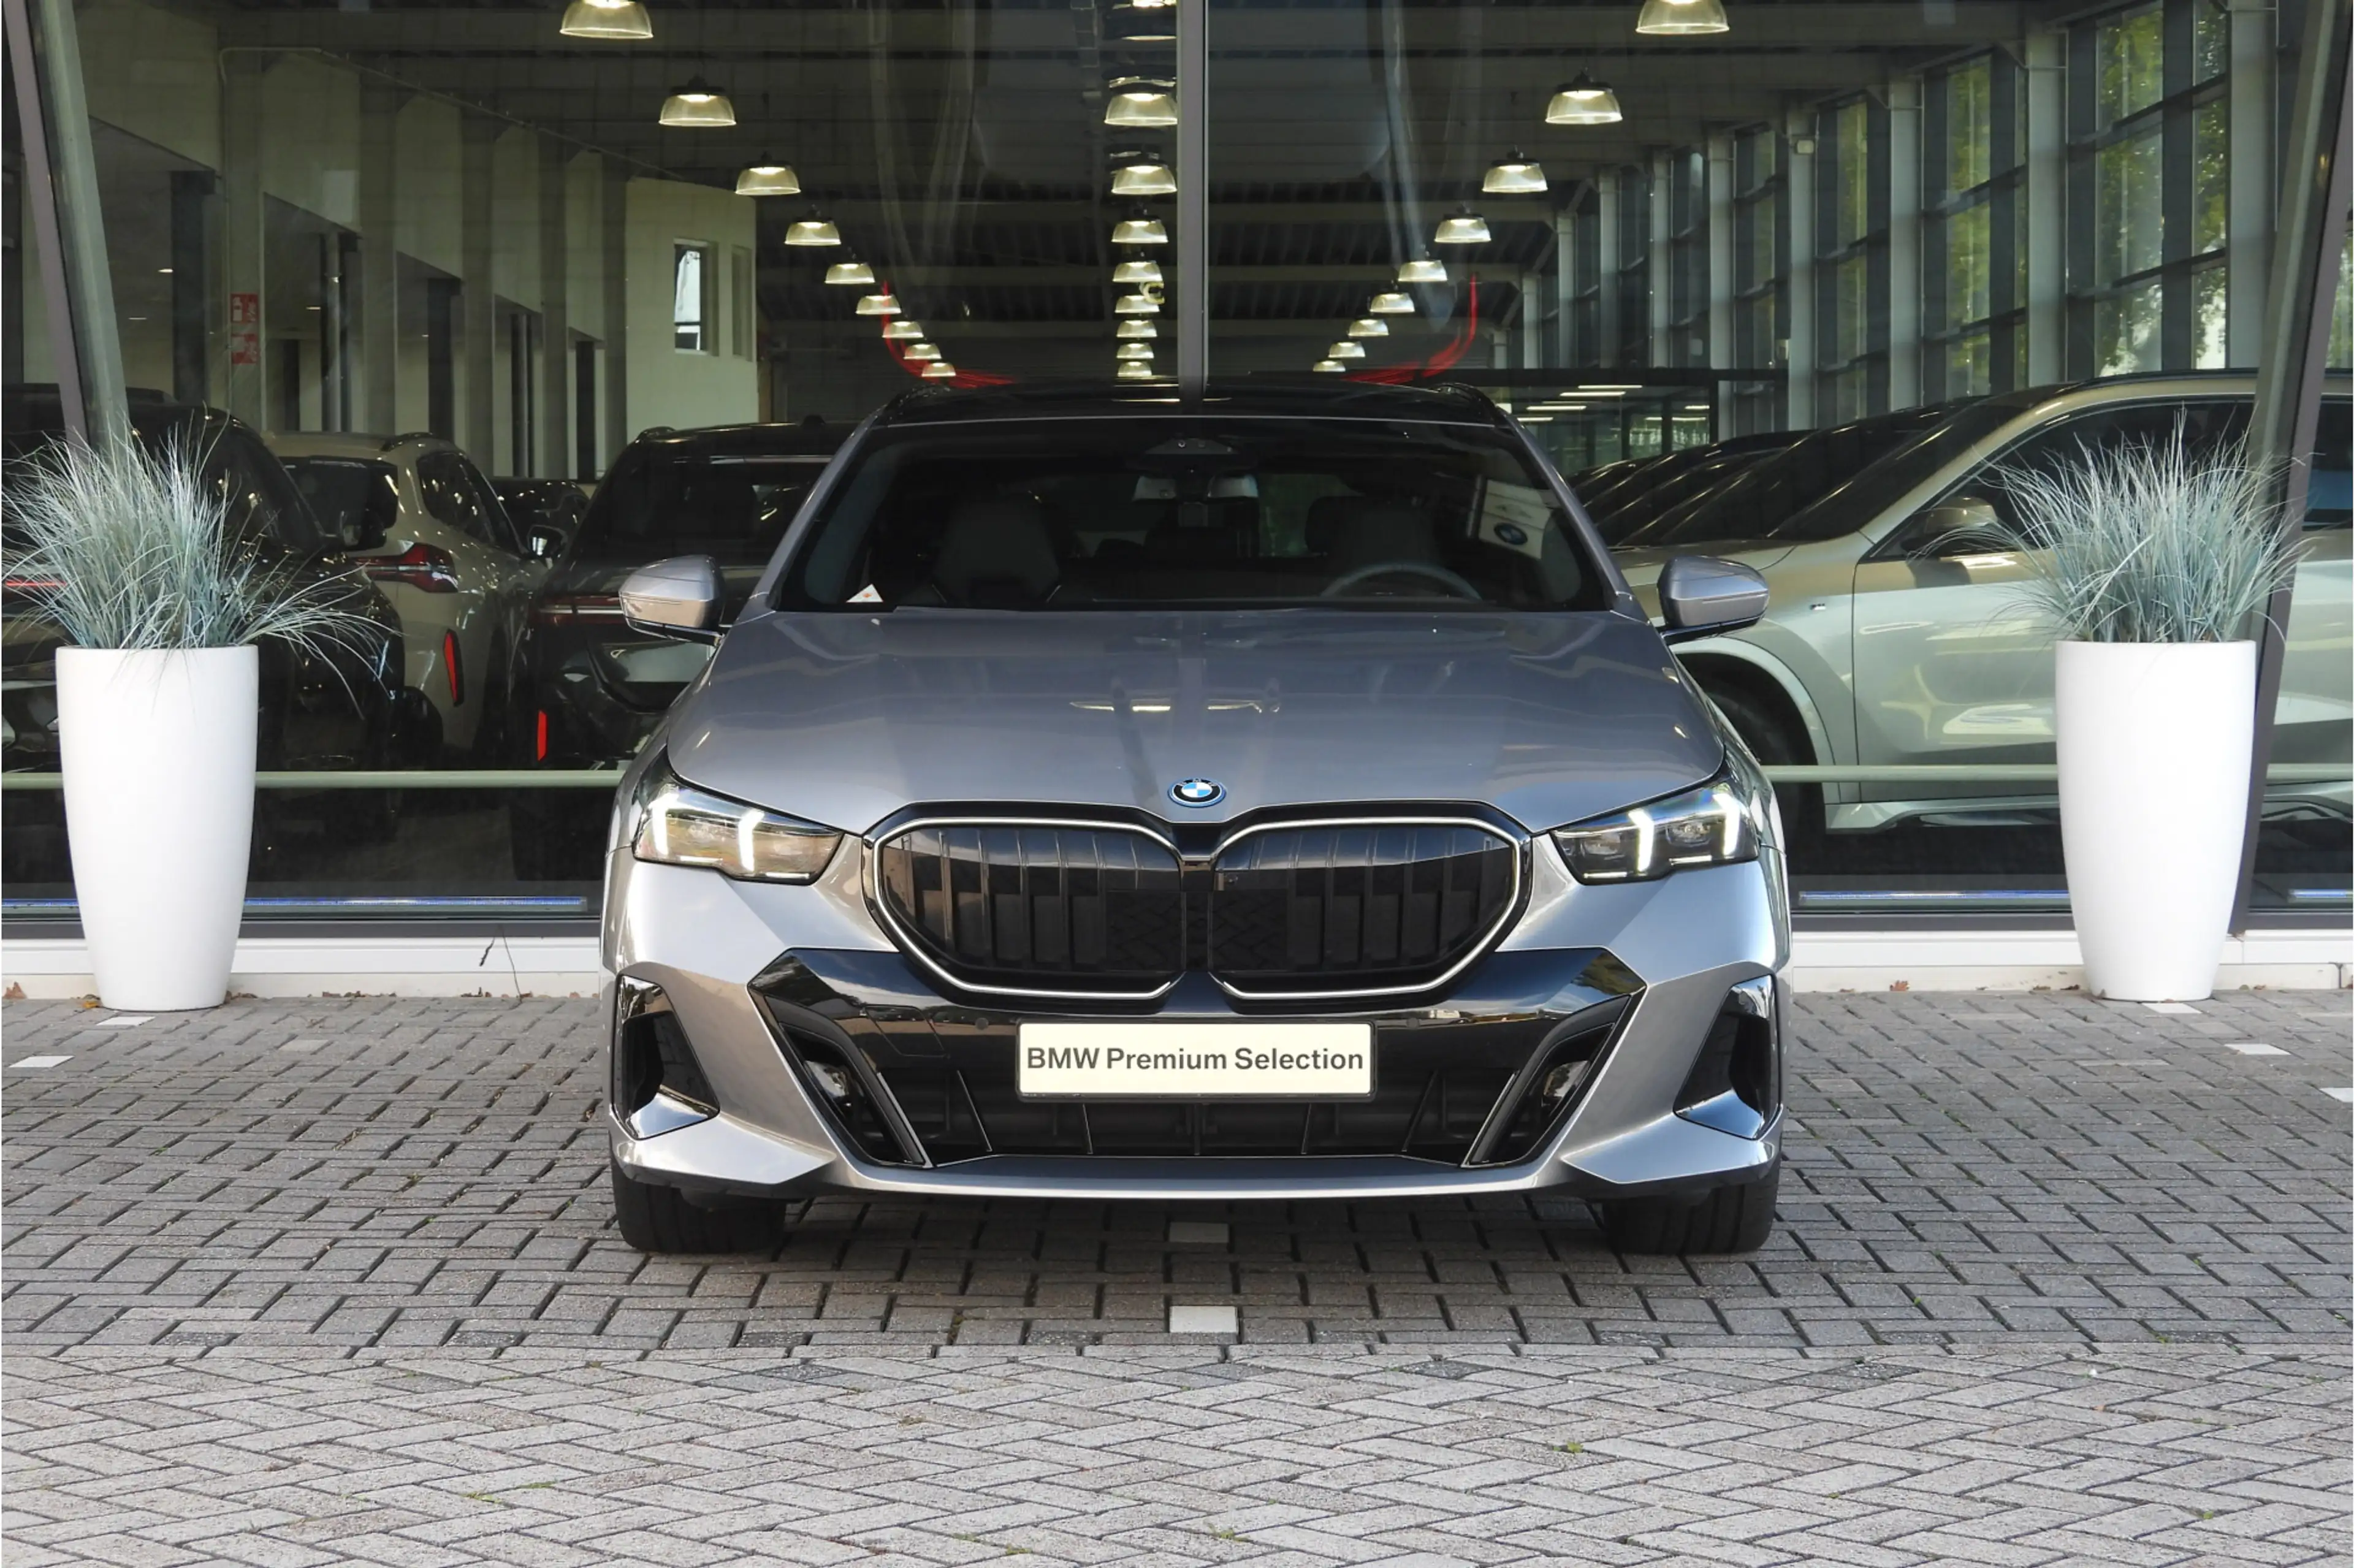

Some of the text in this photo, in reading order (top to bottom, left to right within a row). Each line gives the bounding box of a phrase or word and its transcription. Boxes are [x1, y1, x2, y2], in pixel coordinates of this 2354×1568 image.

[1027, 1048, 1363, 1070] BMW Premium Selection
